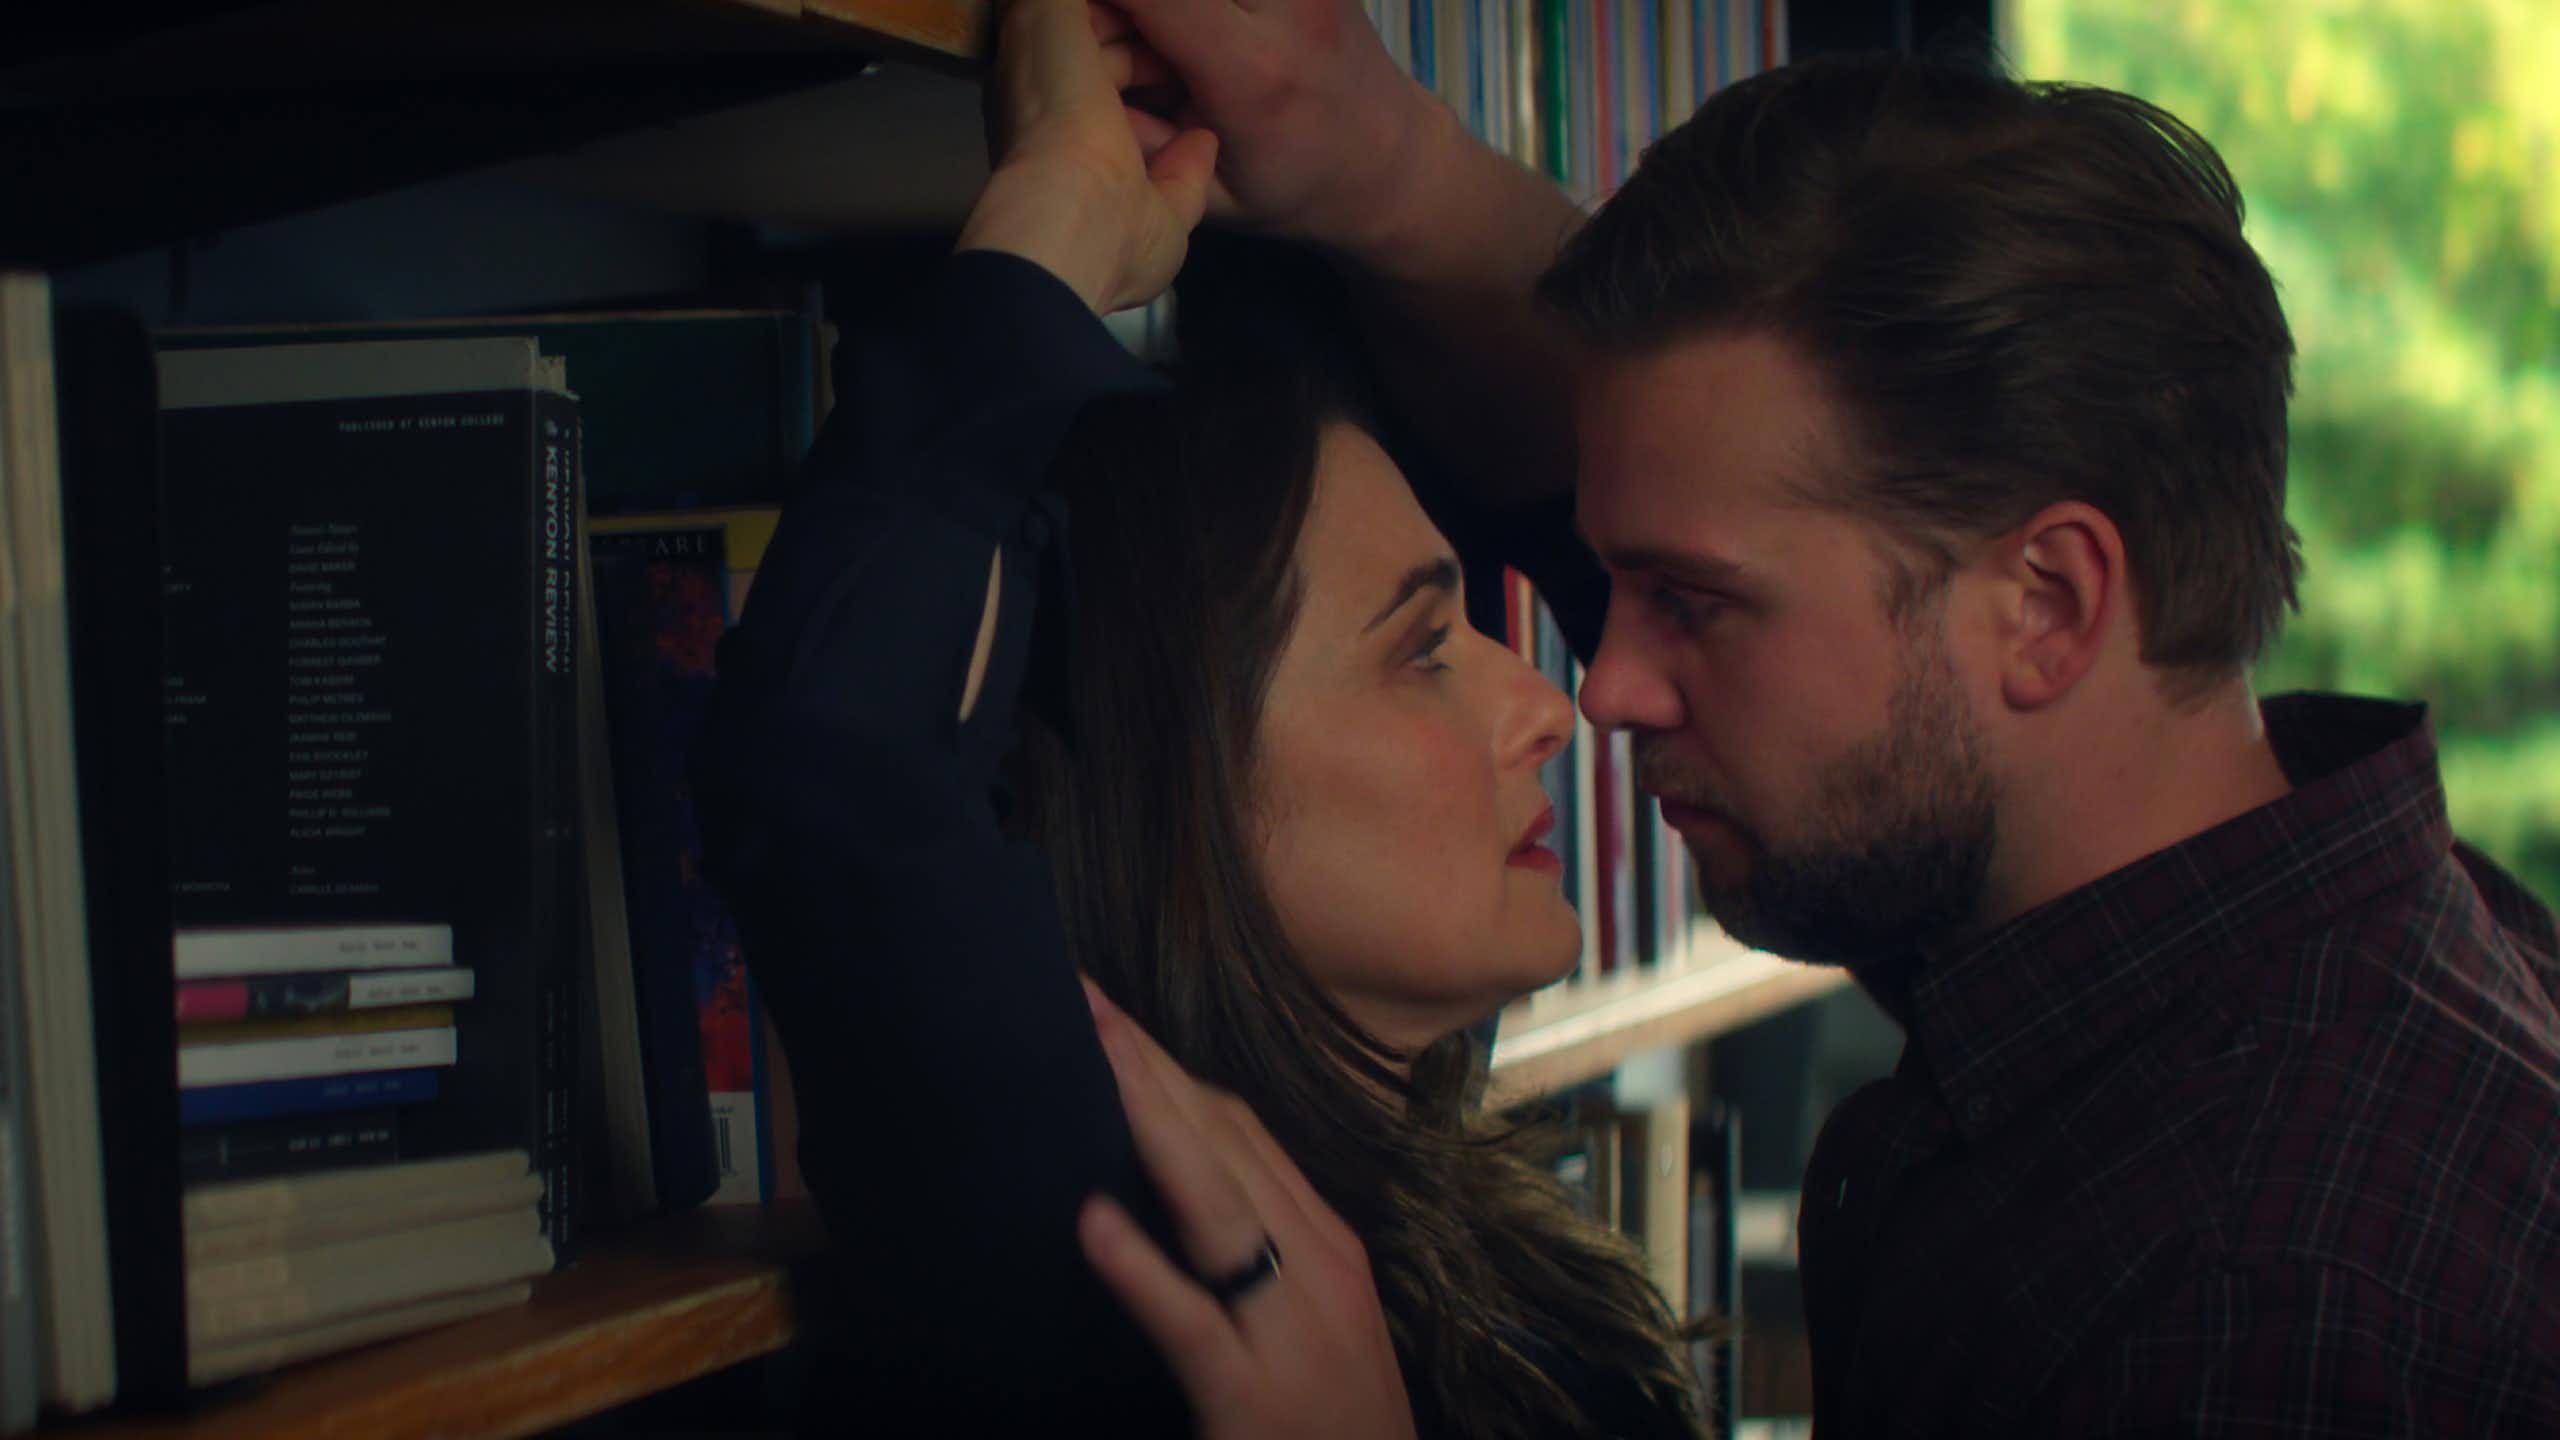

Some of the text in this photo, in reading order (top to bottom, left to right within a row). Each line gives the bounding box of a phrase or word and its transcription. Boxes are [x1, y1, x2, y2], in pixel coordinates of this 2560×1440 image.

[417, 414, 458, 429] KENYON
[461, 411, 504, 427] COLLEGE
[545, 445, 559, 560] KENYON
[545, 566, 559, 673] REVIEW
